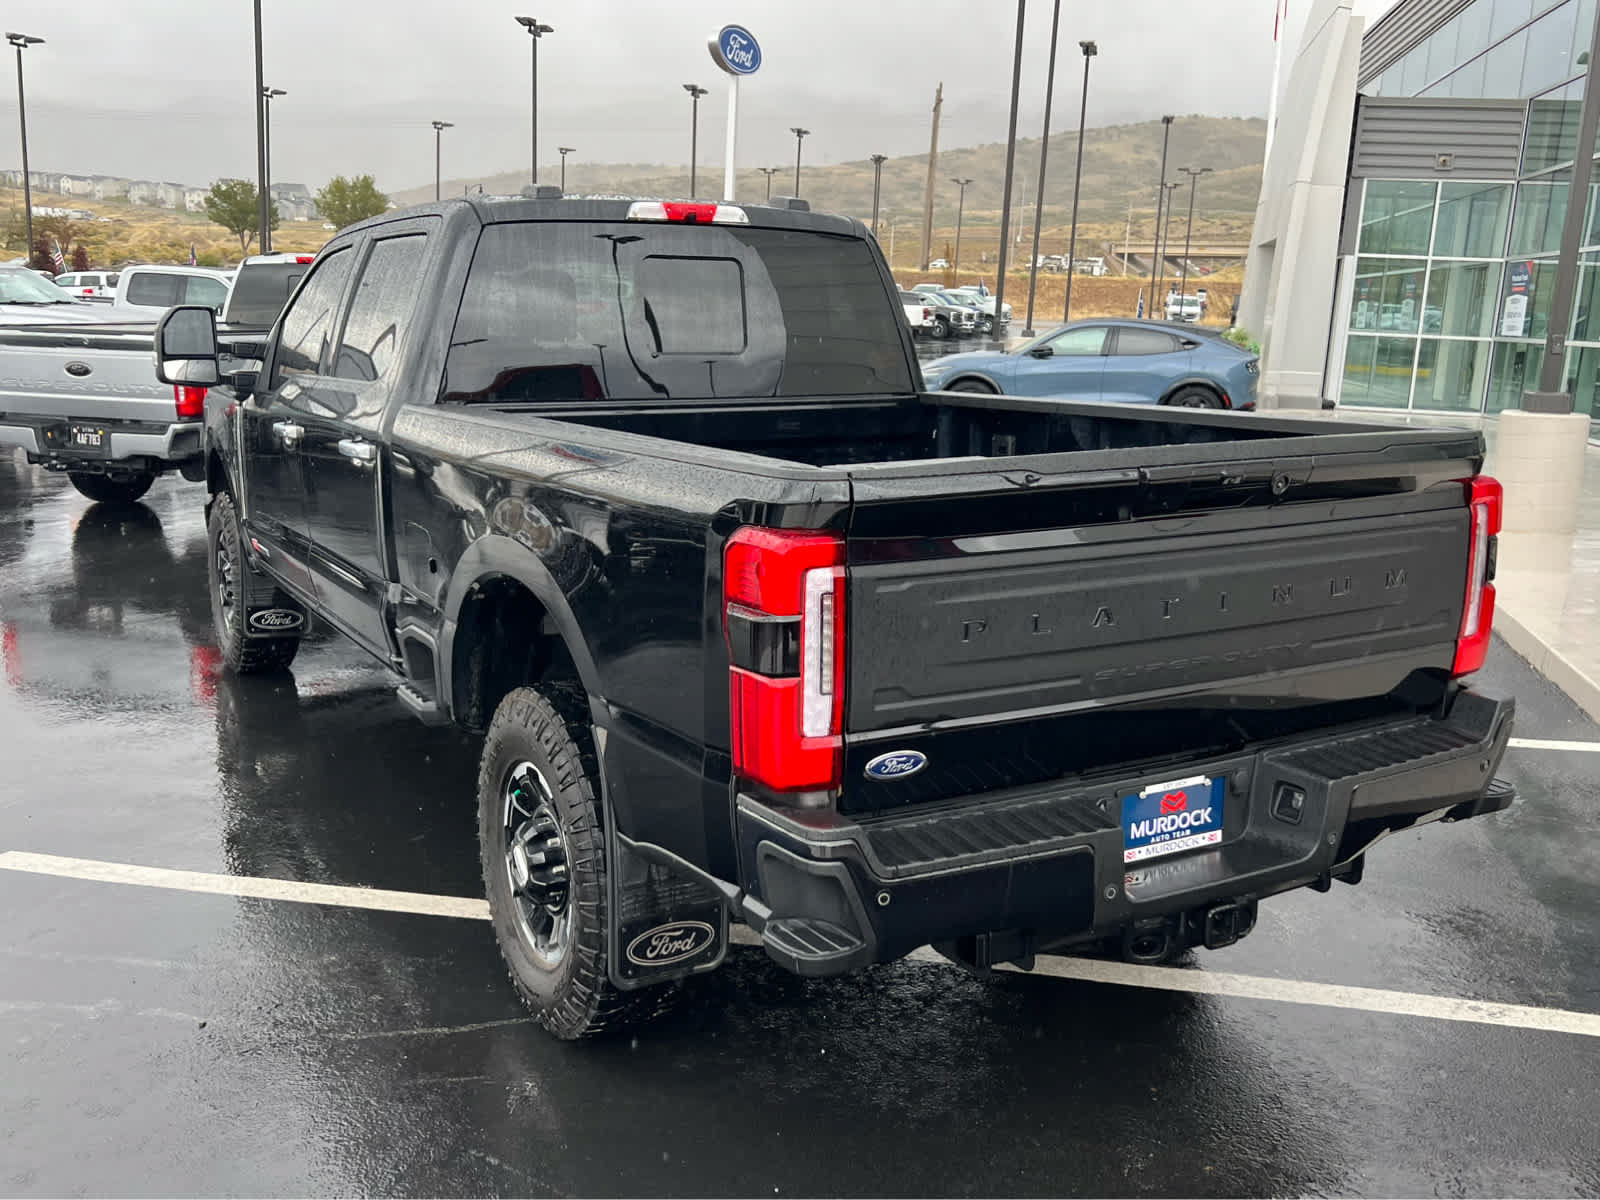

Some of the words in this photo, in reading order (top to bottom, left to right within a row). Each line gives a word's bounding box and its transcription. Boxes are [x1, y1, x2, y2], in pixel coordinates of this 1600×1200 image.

[727, 33, 754, 68] Ford
[960, 568, 1409, 643] PLATINUM
[261, 613, 293, 625] Ford
[881, 756, 914, 773] Ford
[1130, 807, 1212, 839] MURDOCK
[1145, 838, 1200, 856] MURDOCK
[1150, 833, 1170, 844] AUTO
[1172, 829, 1192, 839] TEAM
[646, 929, 697, 959] Ford
